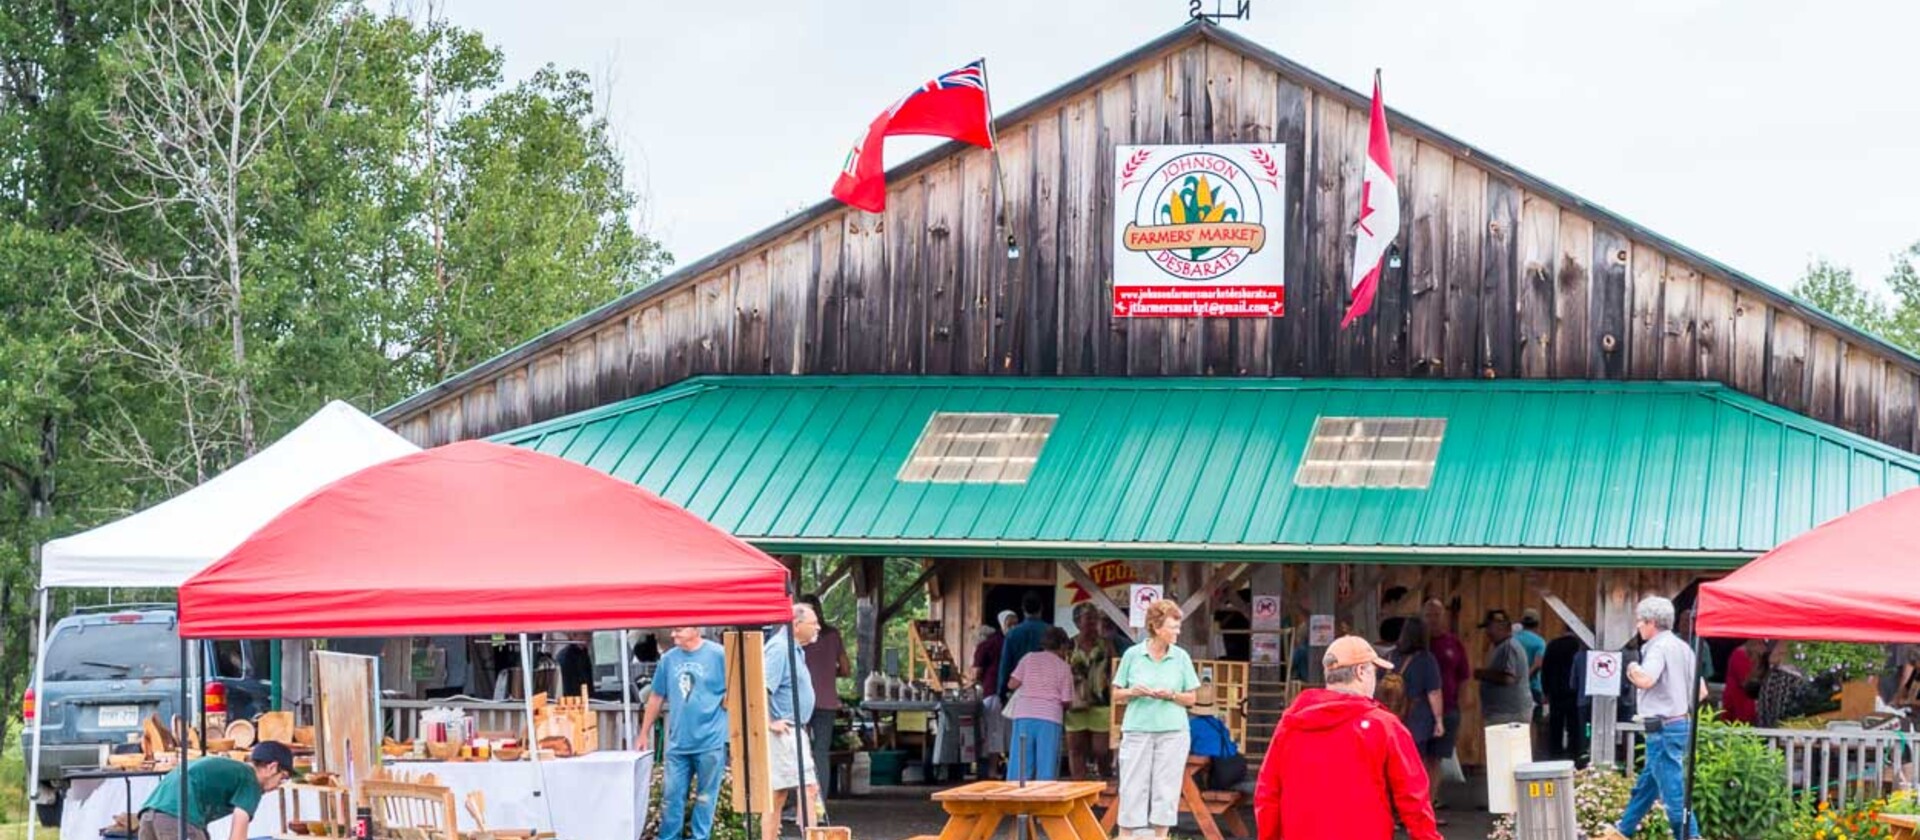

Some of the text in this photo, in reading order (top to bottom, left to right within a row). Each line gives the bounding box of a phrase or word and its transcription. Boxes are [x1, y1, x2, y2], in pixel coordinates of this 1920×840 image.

[1161, 156, 1239, 182] JOHNSON
[1131, 228, 1259, 245] FARMERS' MARKET
[1156, 250, 1241, 276] DESBARATS
